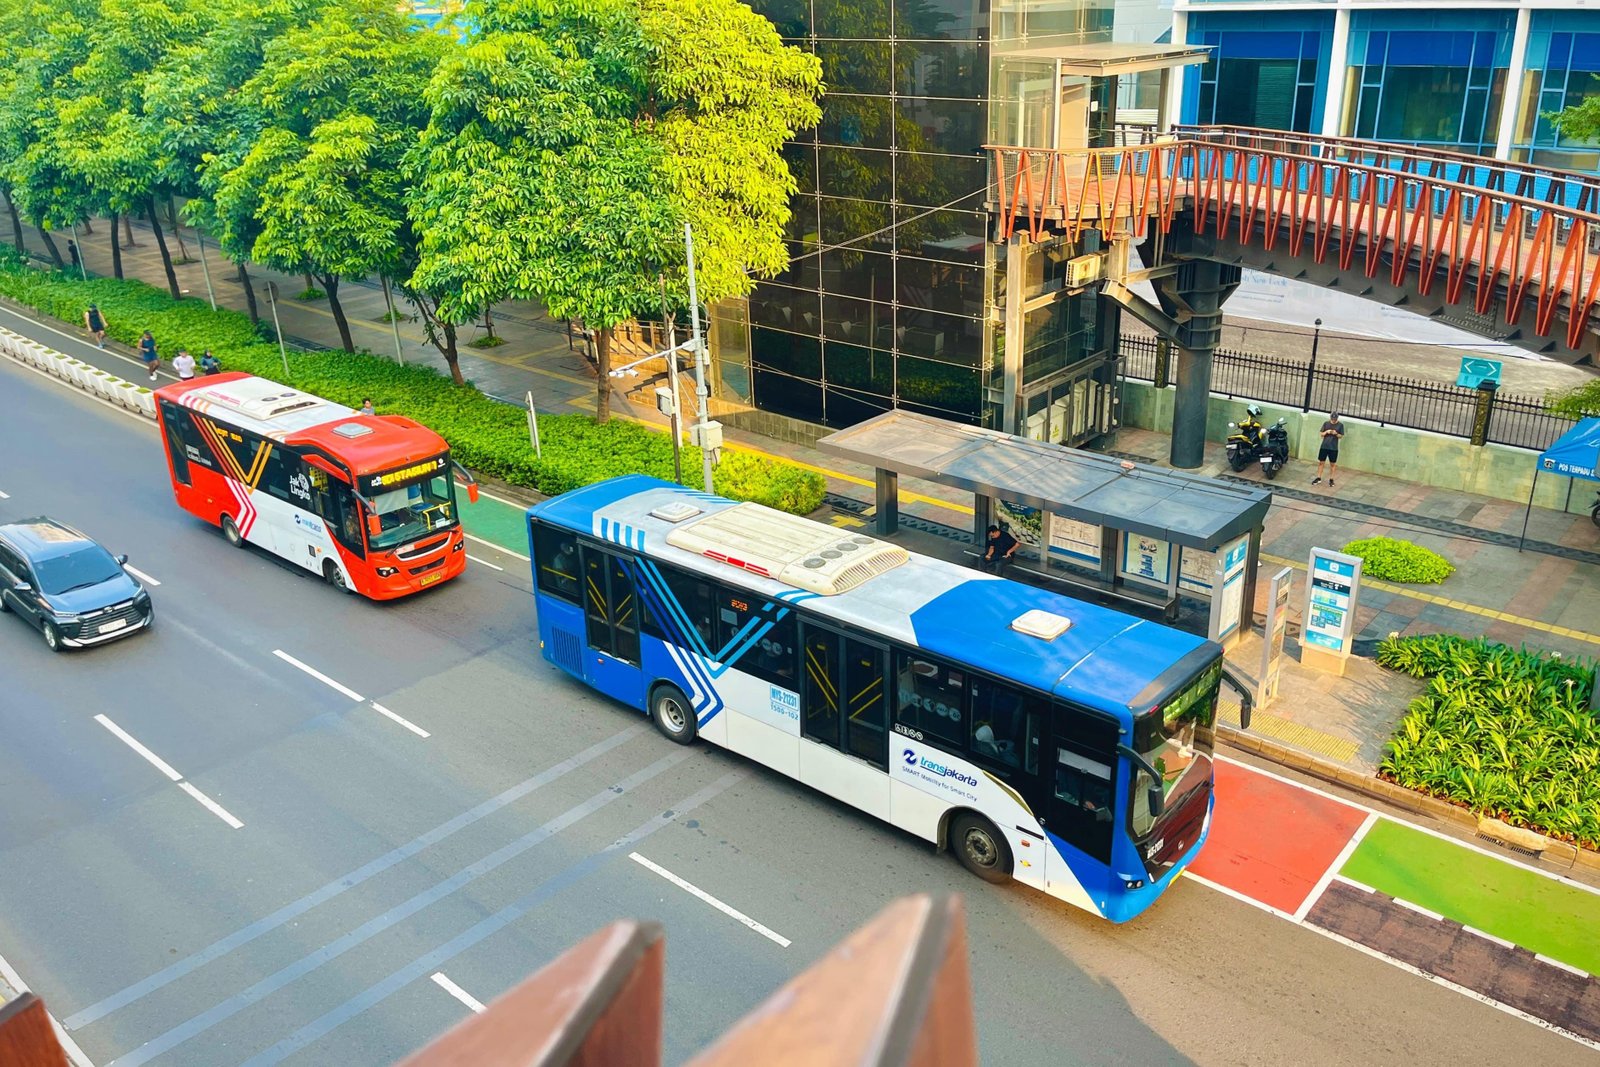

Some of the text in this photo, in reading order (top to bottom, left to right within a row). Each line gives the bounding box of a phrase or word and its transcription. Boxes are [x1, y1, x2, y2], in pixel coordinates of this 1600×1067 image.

[289, 474, 300, 487] Jak
[290, 484, 311, 501] Lingko
[902, 765, 920, 777] SMART
[920, 772, 942, 787] Mobility
[950, 785, 966, 798] Smart
[966, 792, 978, 802] City
[919, 756, 978, 787] transjakarta
